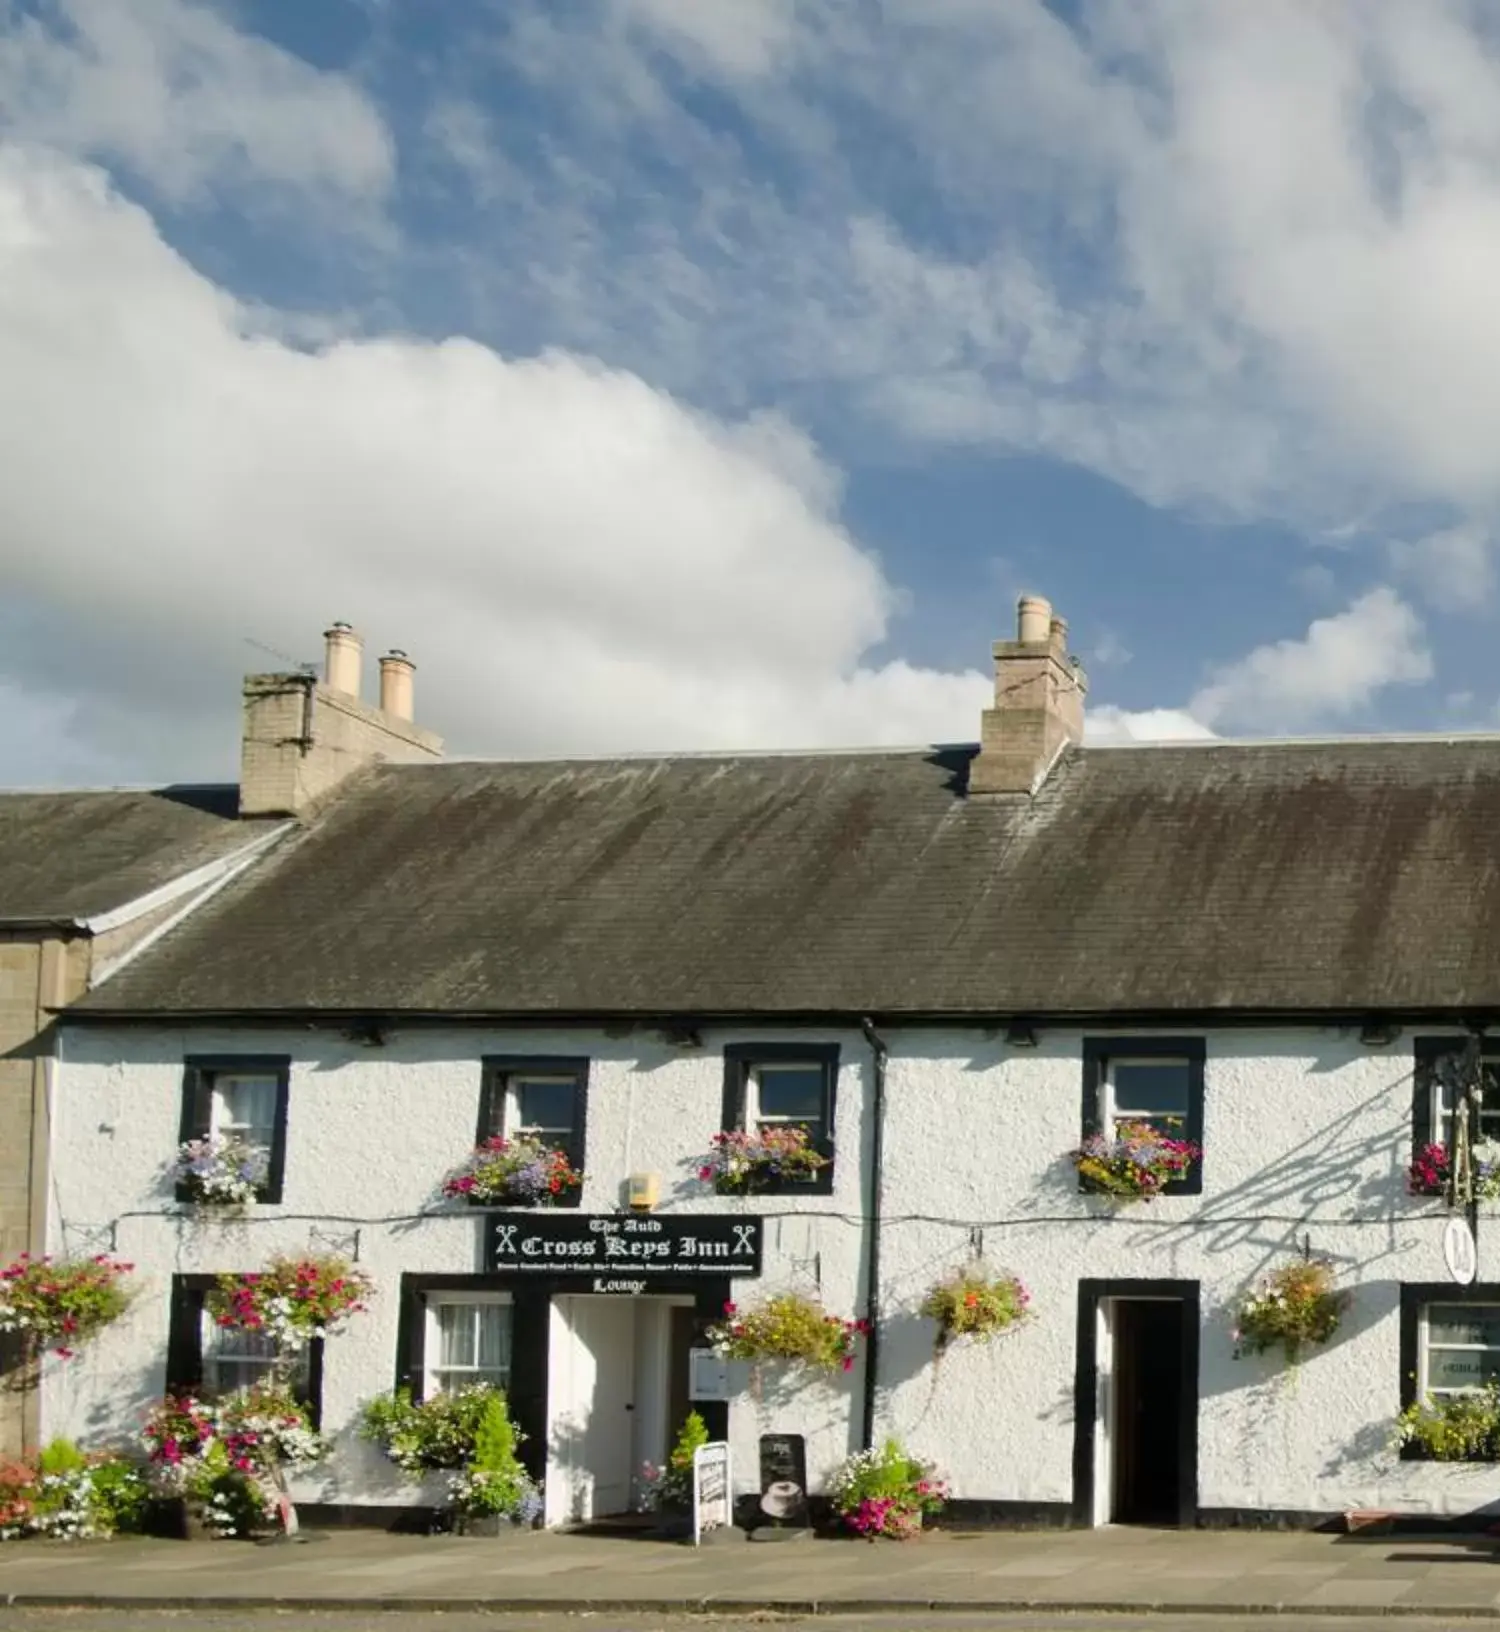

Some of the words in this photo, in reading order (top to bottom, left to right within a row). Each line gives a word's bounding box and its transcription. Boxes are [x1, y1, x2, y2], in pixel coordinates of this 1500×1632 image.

[589, 1219, 619, 1233] The
[624, 1219, 662, 1233] Auld
[521, 1236, 596, 1256] Cross
[605, 1236, 671, 1259] Keys
[678, 1236, 729, 1256] Inn
[593, 1278, 648, 1295] Lounge
